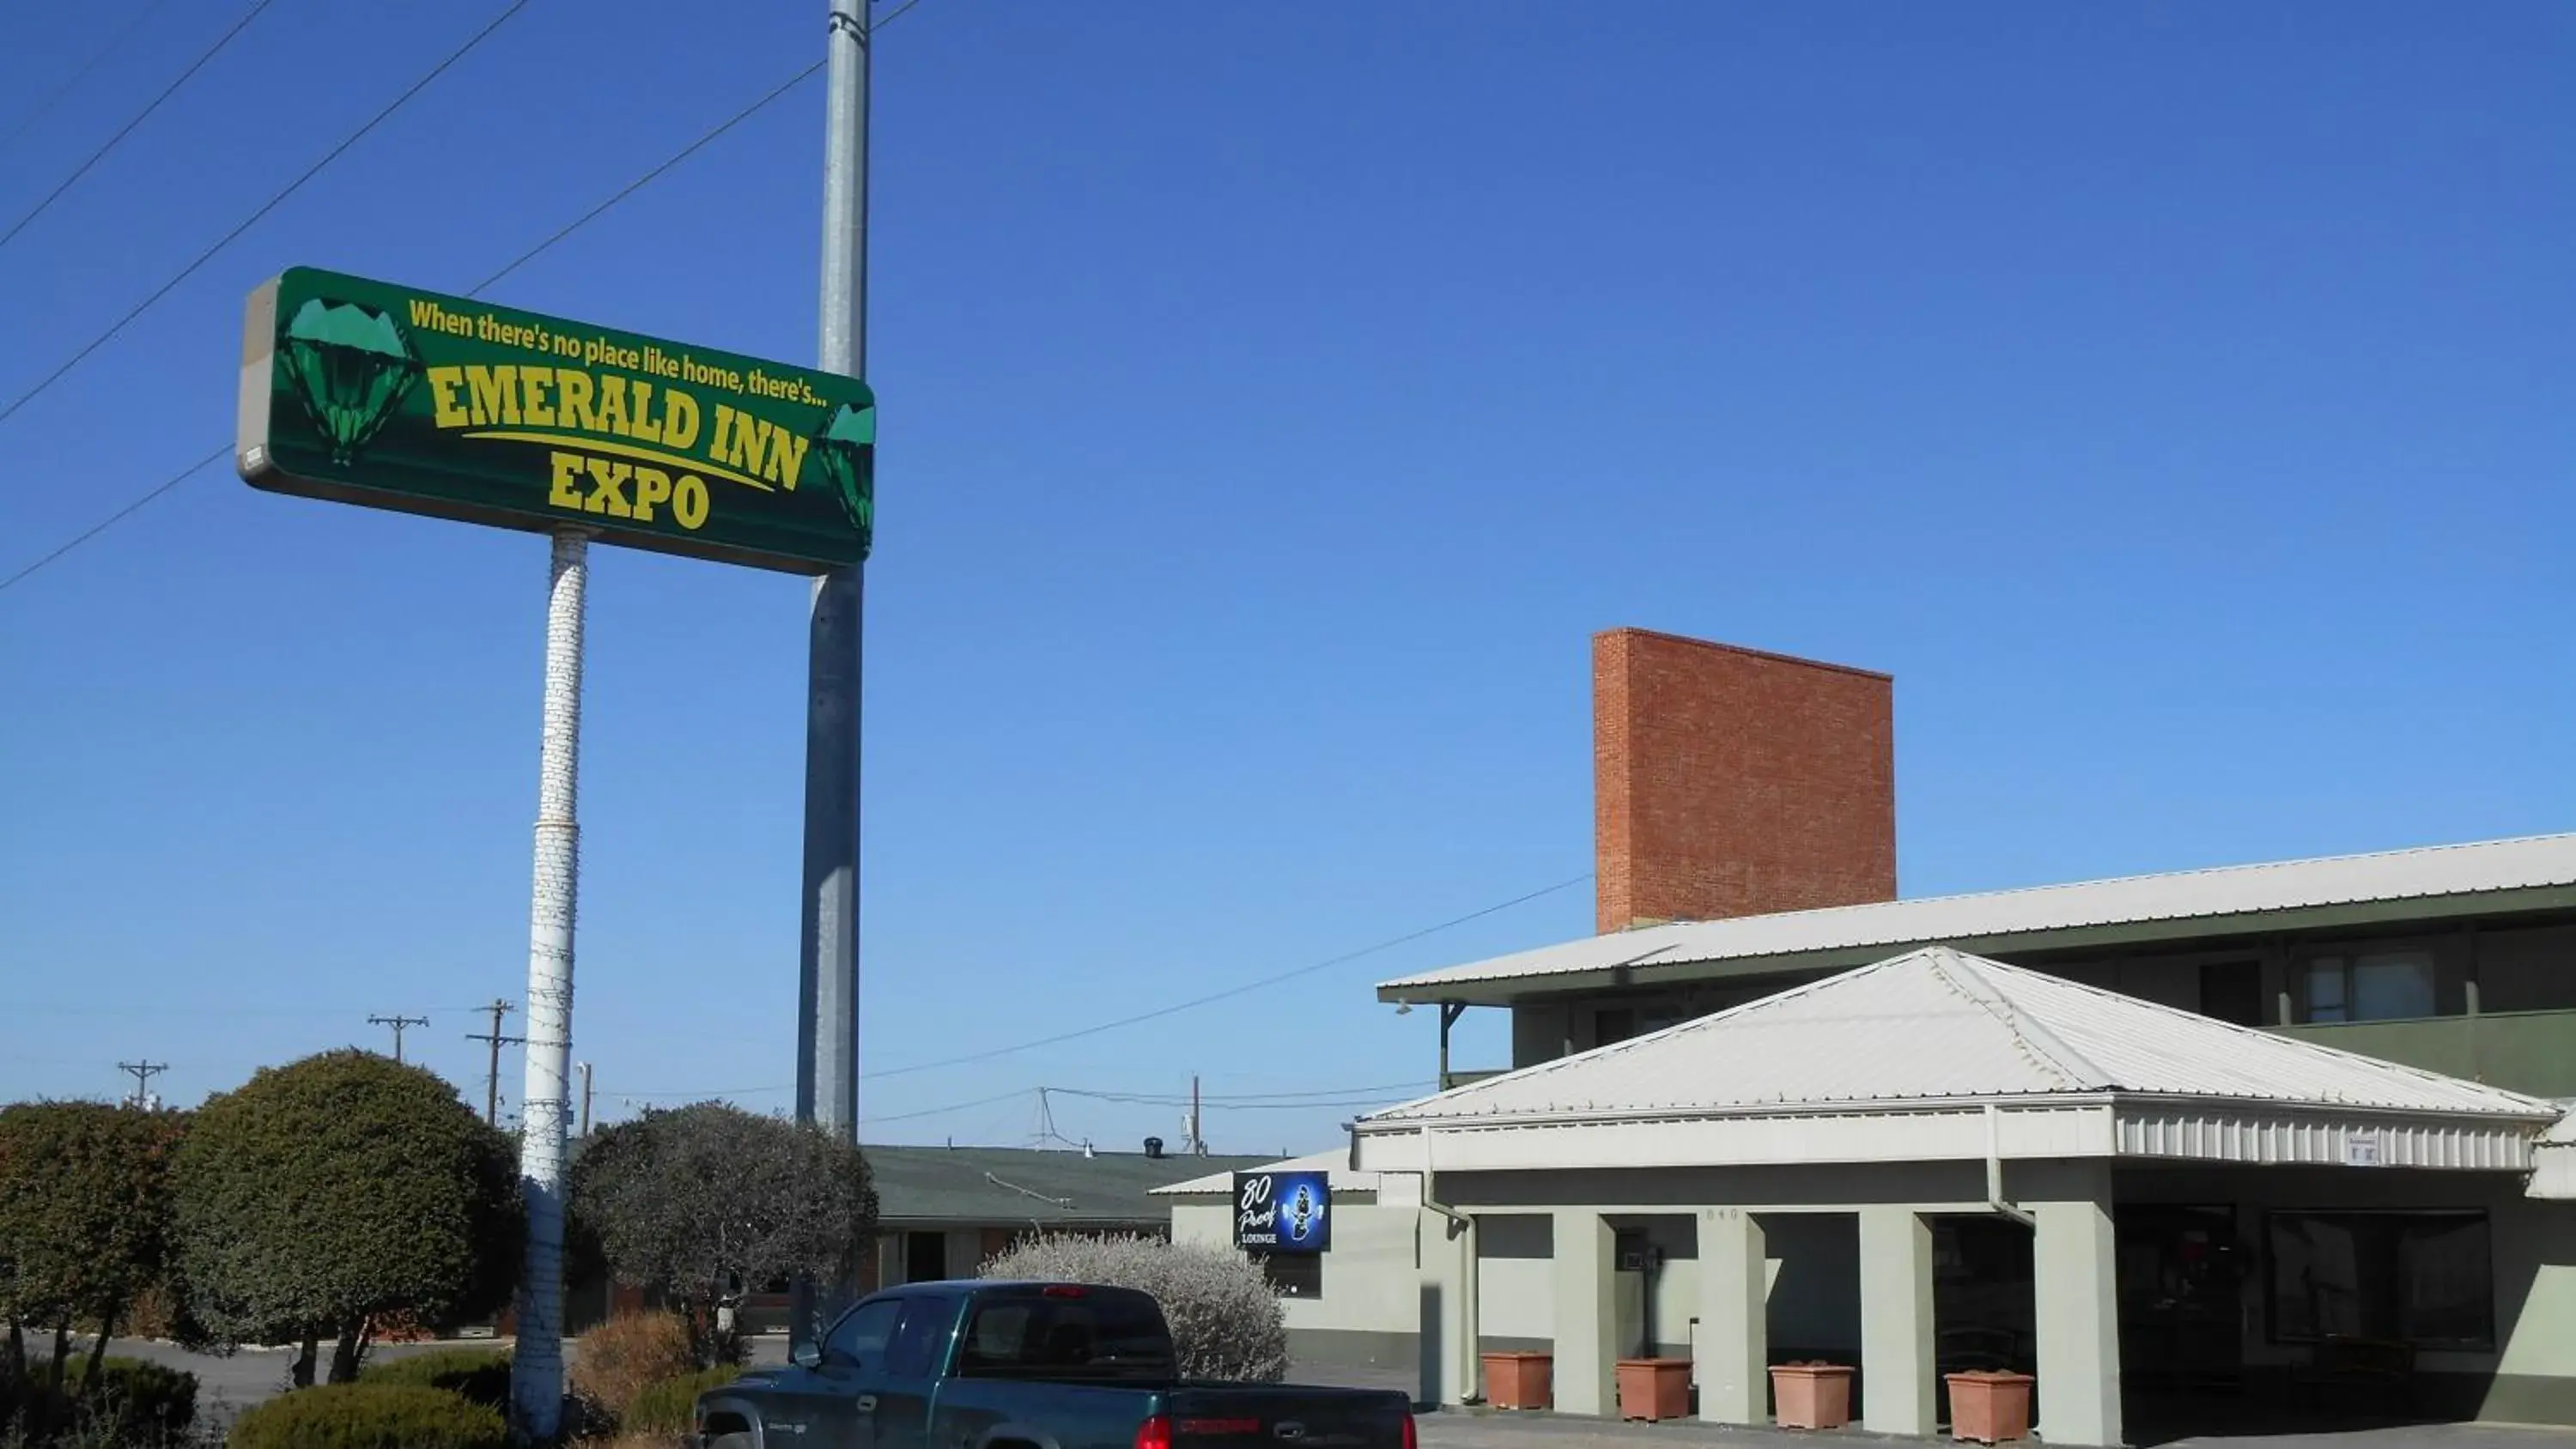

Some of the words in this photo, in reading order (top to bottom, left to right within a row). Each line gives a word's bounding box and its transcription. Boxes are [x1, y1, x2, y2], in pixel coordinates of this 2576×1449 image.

[409, 300, 473, 337] When
[477, 314, 550, 351] there's
[554, 334, 581, 358] no
[585, 336, 640, 369] place
[643, 345, 679, 379] like
[683, 355, 744, 394] home,
[748, 368, 827, 407] there's...
[427, 365, 700, 449] EMERALD
[709, 403, 810, 492] INN
[549, 451, 709, 530] EXPO
[1238, 1200, 1277, 1233] Proof
[1241, 1174, 1271, 1210] 80
[1242, 1234, 1277, 1244] LOUNGE
